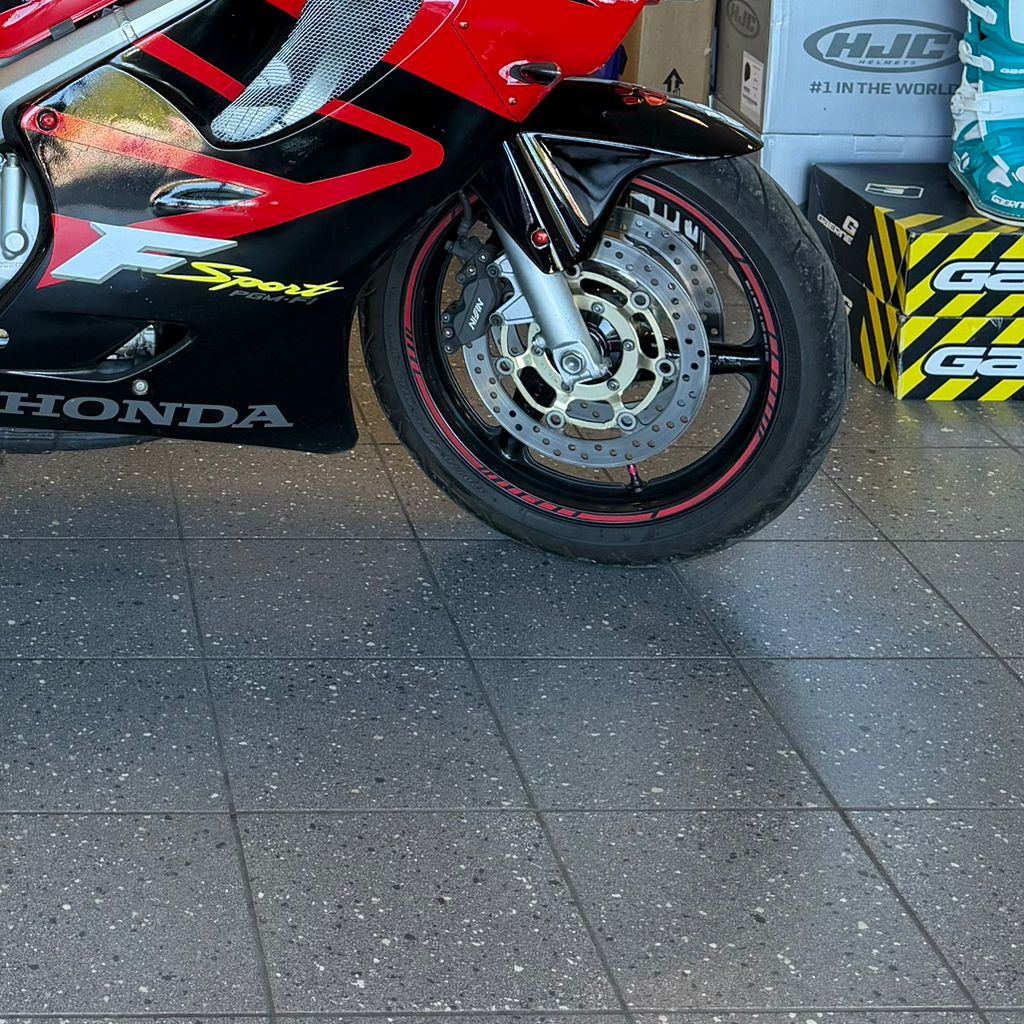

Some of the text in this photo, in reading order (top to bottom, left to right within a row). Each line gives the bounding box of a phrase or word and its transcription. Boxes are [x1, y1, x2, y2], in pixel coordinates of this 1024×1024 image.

[730, 2, 757, 34] HJC
[824, 32, 950, 59] HJC
[809, 81, 961, 95] #1 IN THE WORLD
[51, 221, 238, 285] F
[156, 261, 344, 297] Sport
